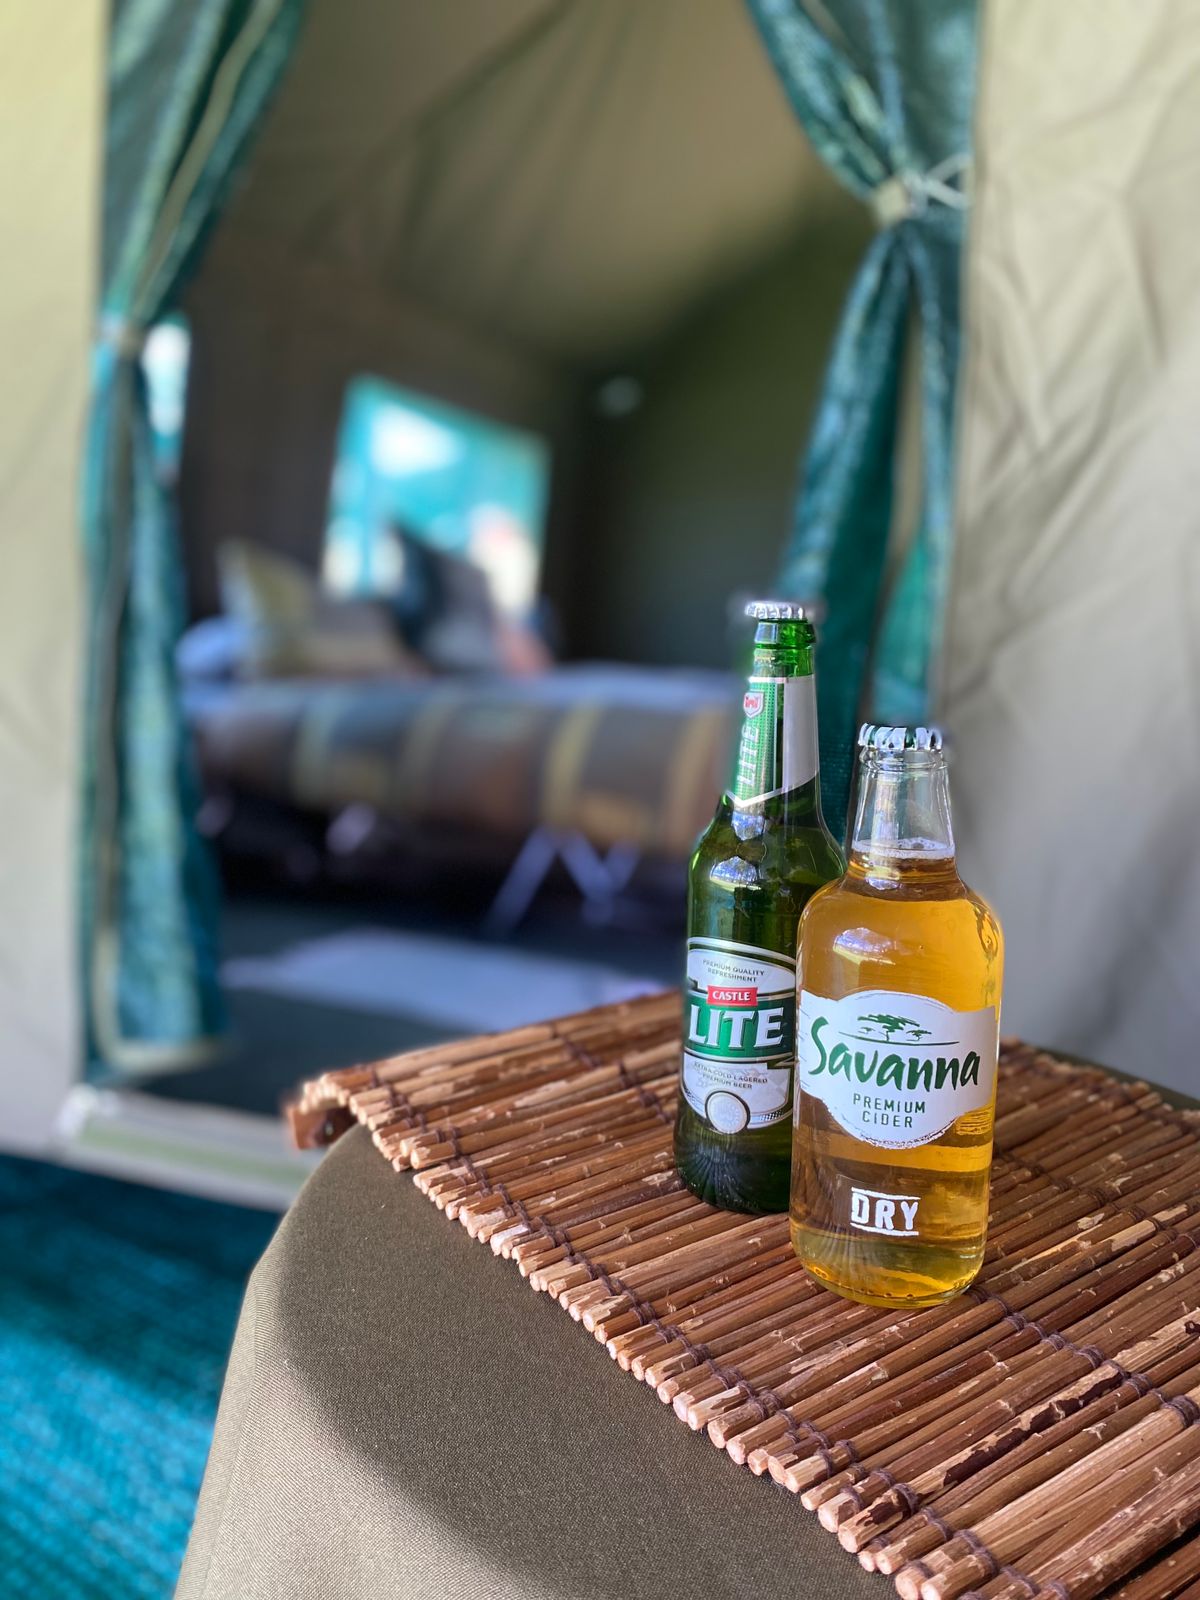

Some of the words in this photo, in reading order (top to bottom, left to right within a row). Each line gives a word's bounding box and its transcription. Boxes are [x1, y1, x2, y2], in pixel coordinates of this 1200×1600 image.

[703, 959, 731, 971] PREMIUM
[732, 966, 765, 976] QUALITY
[707, 968, 757, 983] REFRESHMENT
[712, 990, 751, 1002] CASTLE
[688, 1004, 784, 1049] LITE
[808, 1016, 980, 1092] Savanna
[733, 1081, 753, 1090] BEER
[853, 1094, 926, 1113] PREMIUM
[862, 1110, 913, 1128] CIDER
[851, 1191, 919, 1230] DRY
